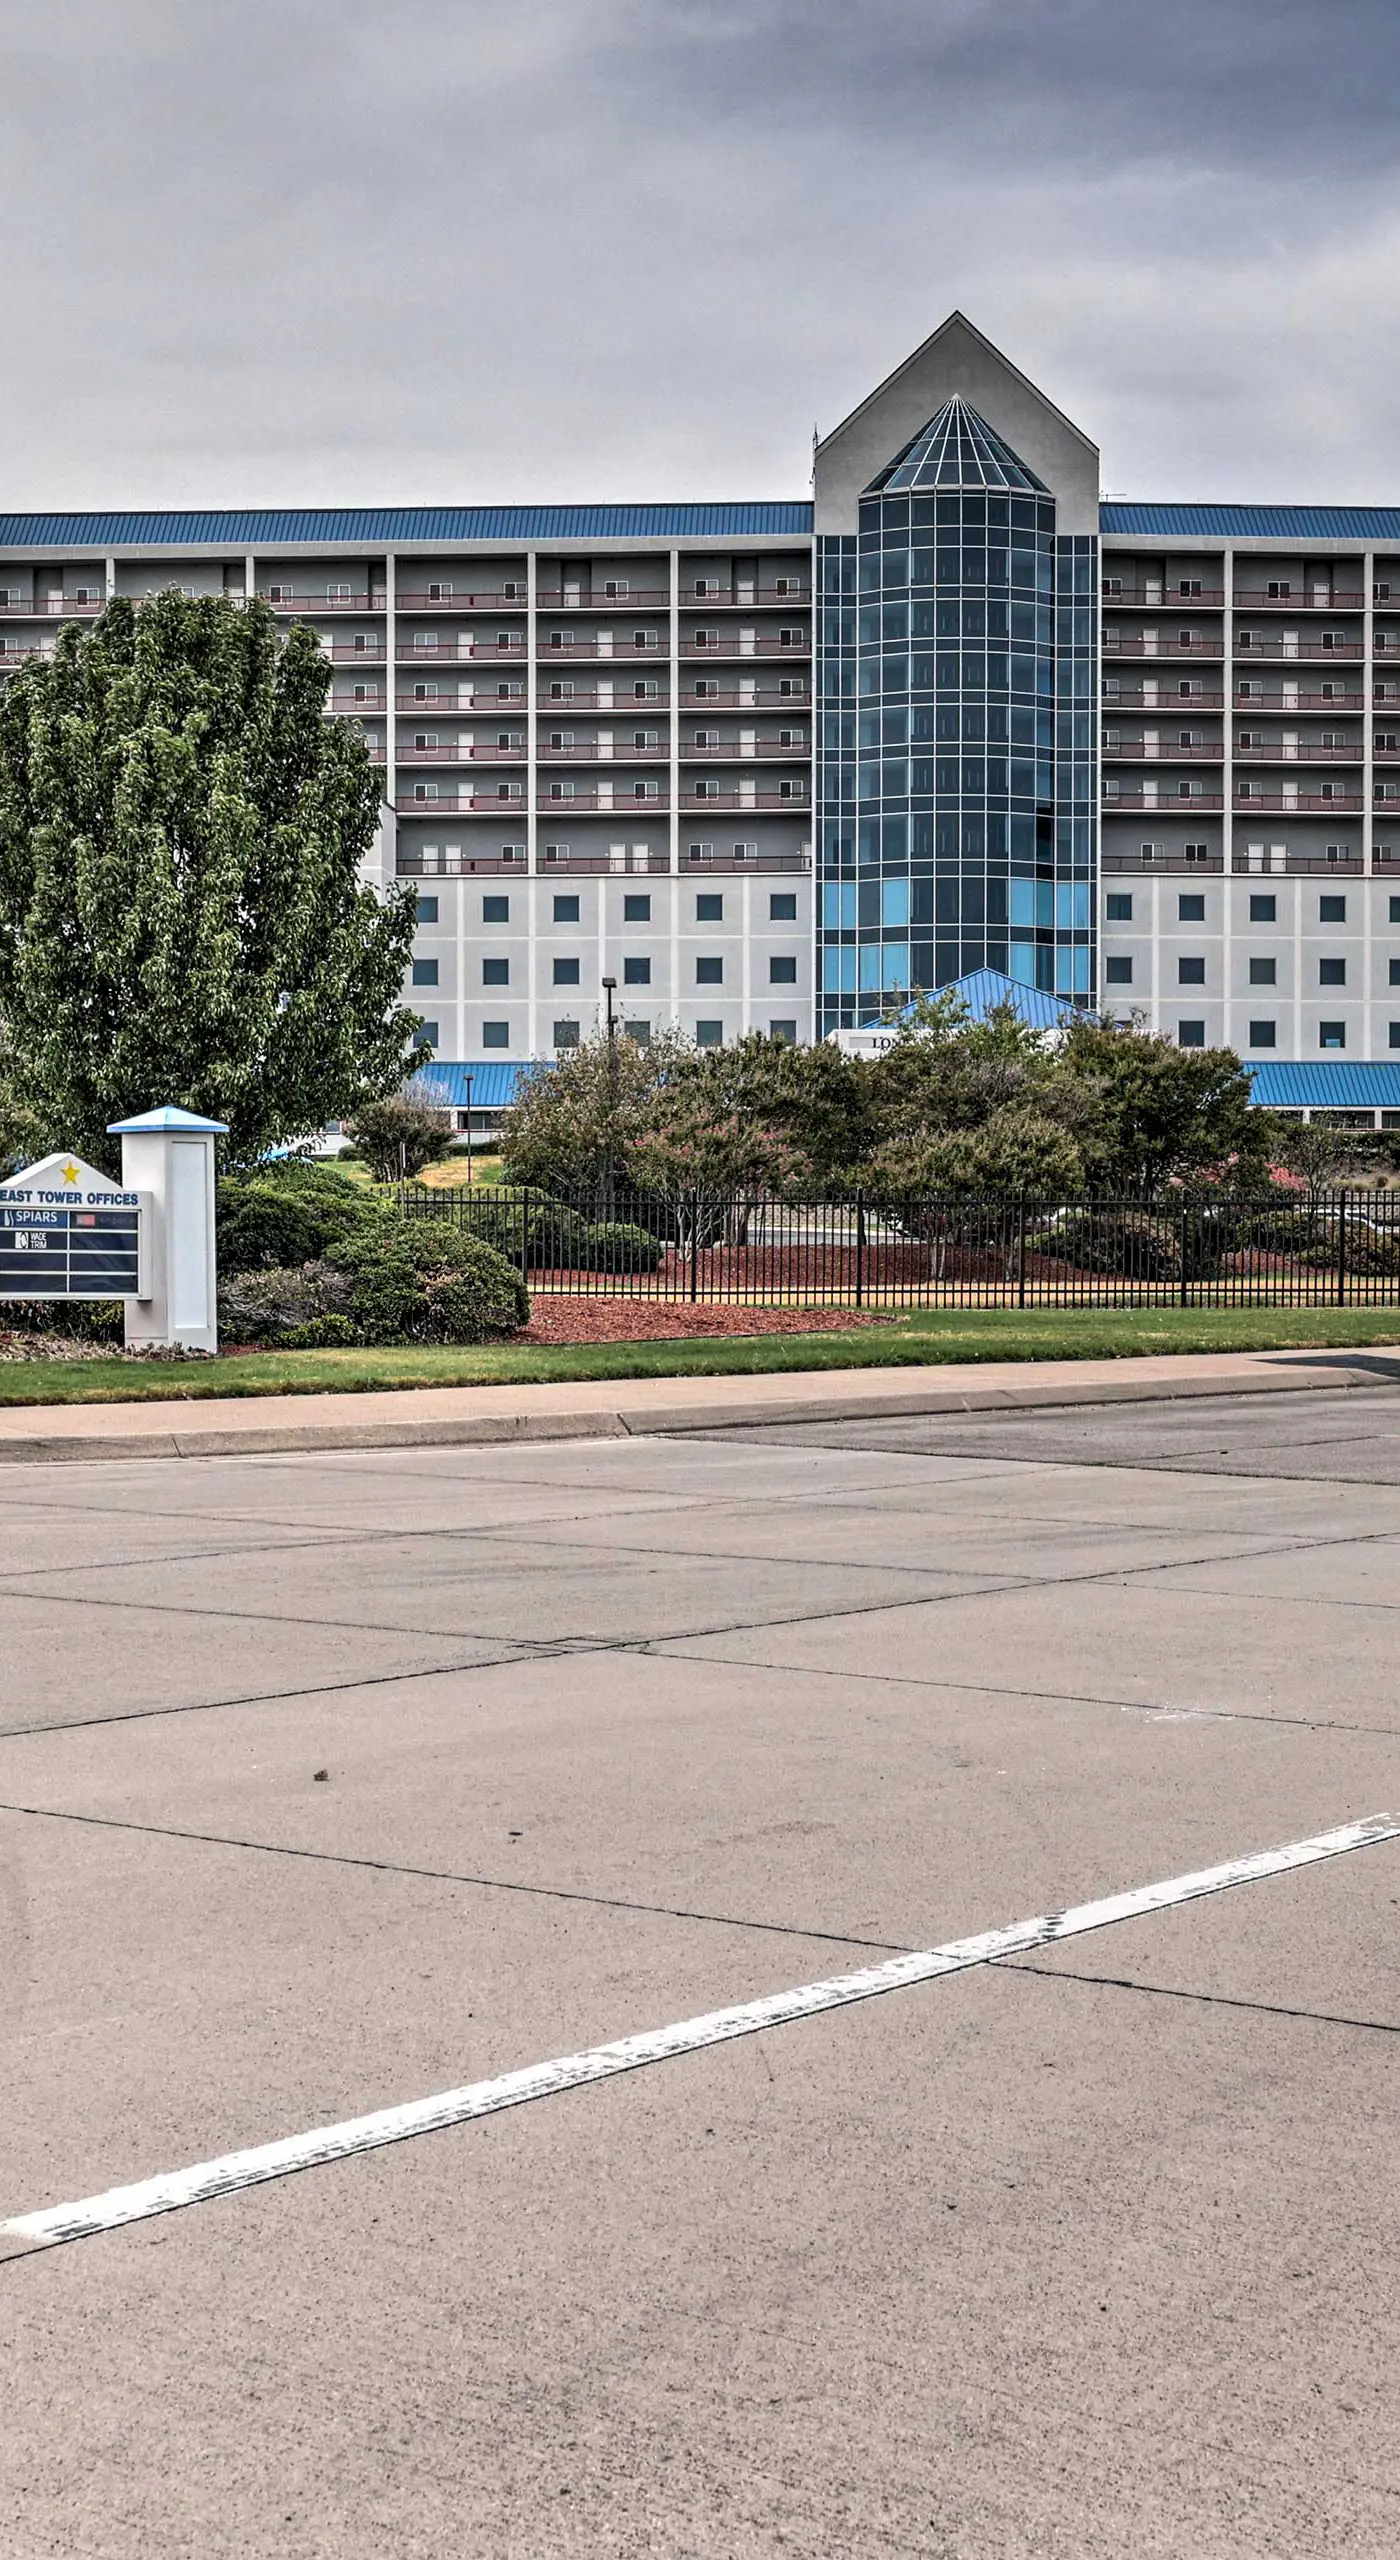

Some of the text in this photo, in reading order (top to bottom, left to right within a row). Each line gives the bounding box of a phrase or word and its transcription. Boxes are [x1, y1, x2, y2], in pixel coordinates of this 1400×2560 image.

[0, 1190, 138, 1205] EAST TOWER OFFICES
[16, 1211, 58, 1223] SPIARS
[30, 1232, 47, 1241] WADE
[30, 1241, 47, 1249] TRIM
